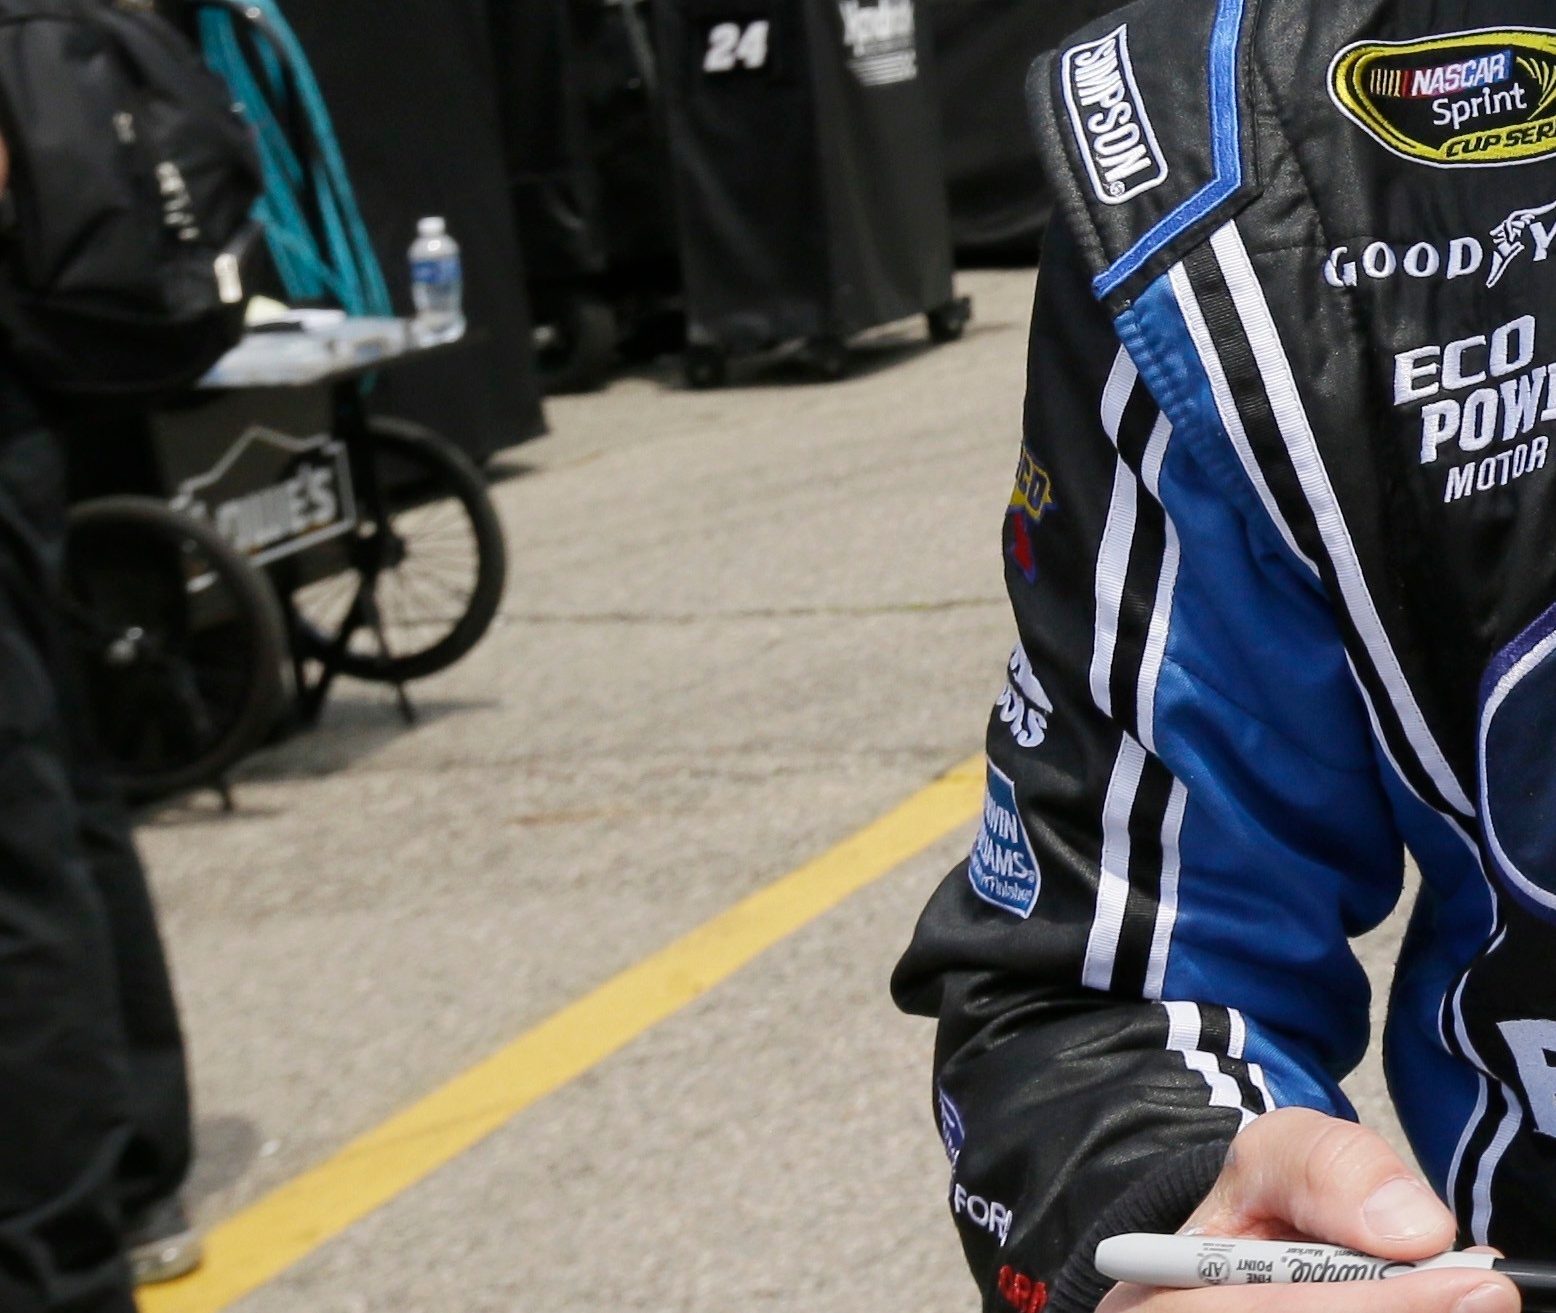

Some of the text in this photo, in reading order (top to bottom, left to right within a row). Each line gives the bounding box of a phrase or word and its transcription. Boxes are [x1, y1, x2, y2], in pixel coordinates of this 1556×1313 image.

[703, 19, 769, 73] 24
[1411, 53, 1507, 97] NASCAR
[1074, 38, 1151, 183] SIMPSON
[1432, 82, 1527, 130] Sprint
[1446, 133, 1502, 159] CUP
[1393, 314, 1536, 406] ECO
[1443, 435, 1550, 503] MOTOR
[1236, 1258, 1273, 1272] POINT
